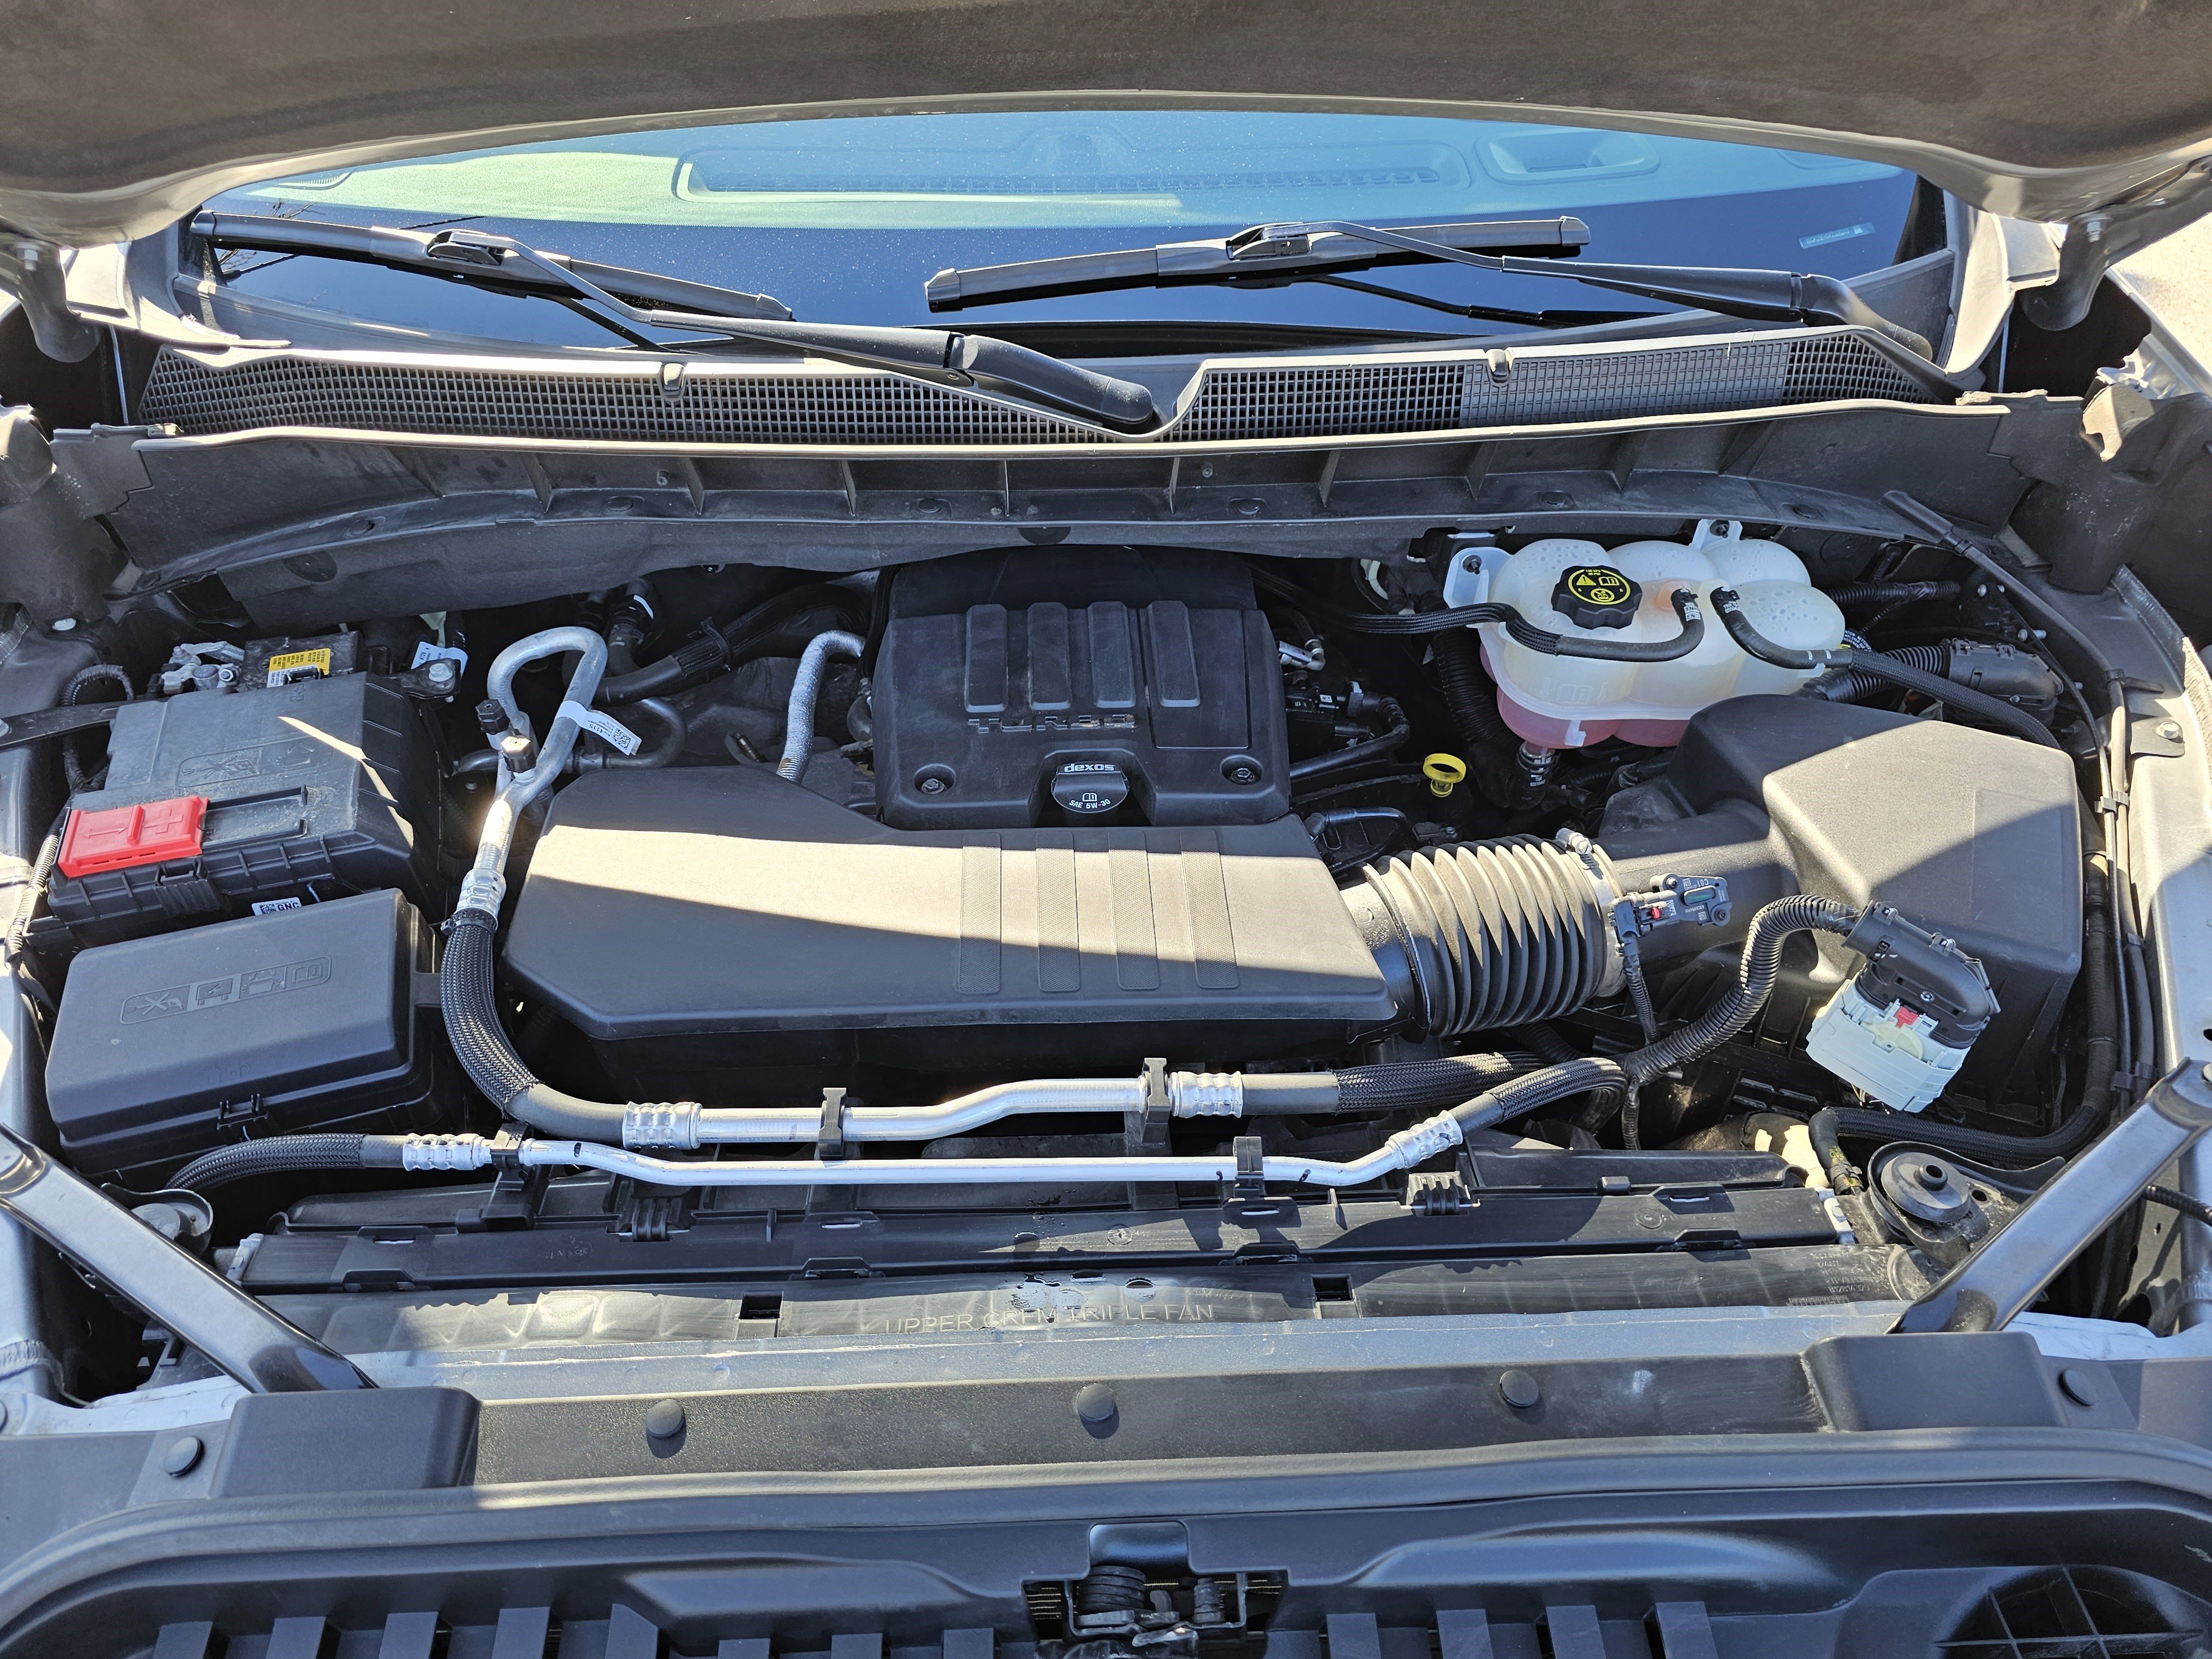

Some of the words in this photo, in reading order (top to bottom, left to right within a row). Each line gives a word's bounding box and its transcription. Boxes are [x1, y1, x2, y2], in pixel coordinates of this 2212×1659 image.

[1064, 763, 1116, 773] dexos
[1069, 800, 1083, 808] SAE
[1086, 799, 1111, 809] 5W-30
[885, 1314, 974, 1334] UPPER
[1063, 1304, 1157, 1322] TRIPLE
[1164, 1304, 1215, 1322] FAN
